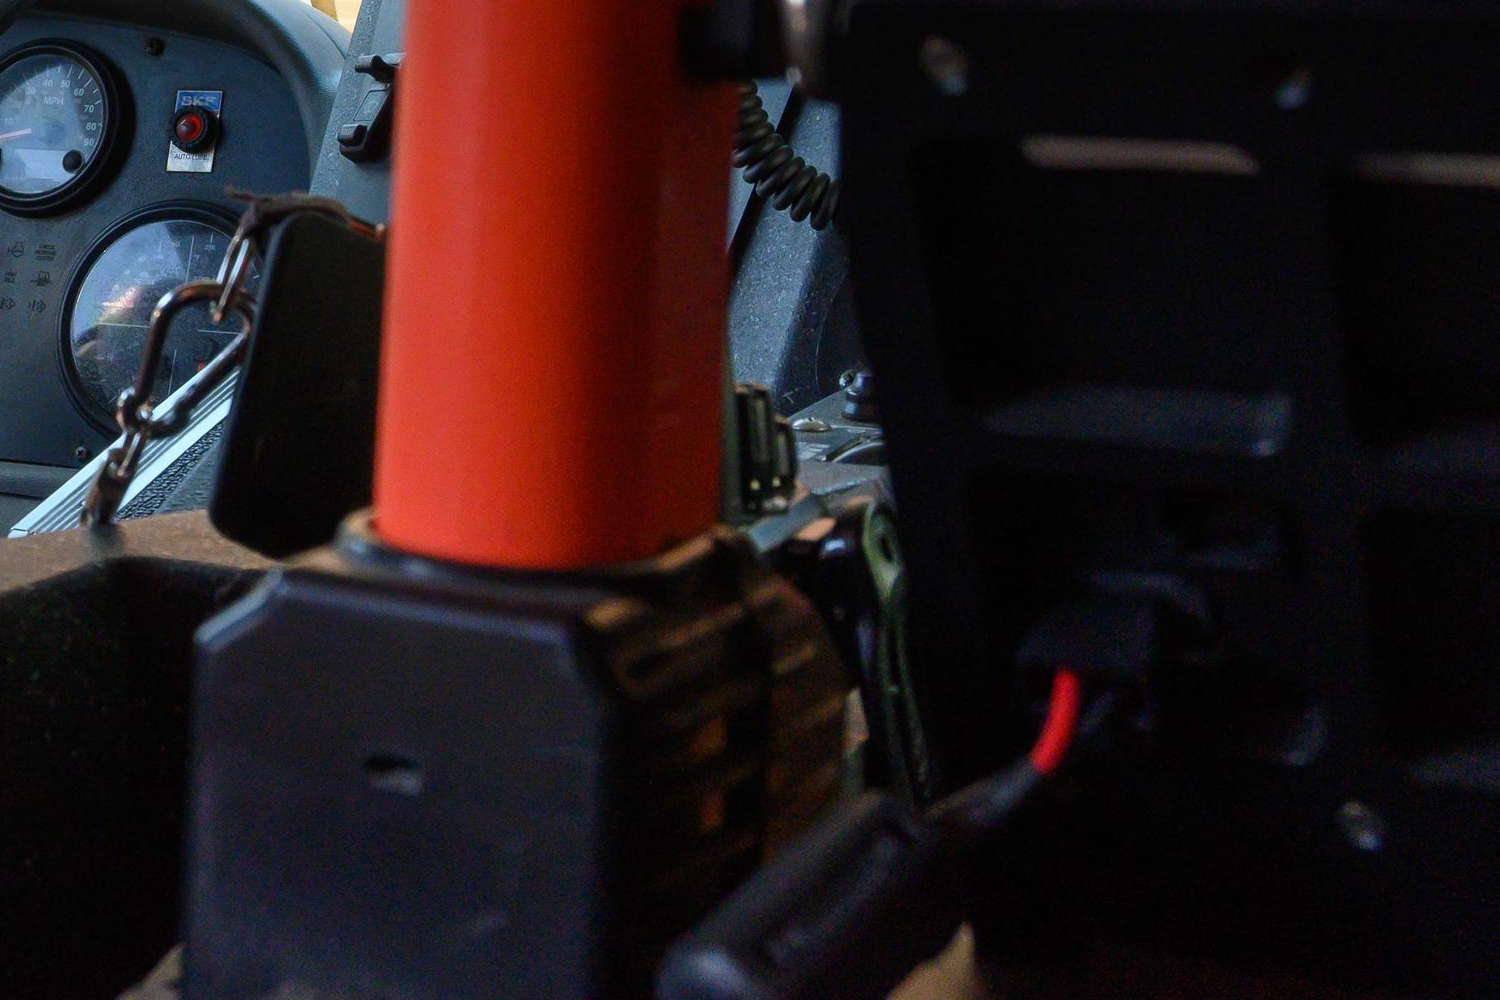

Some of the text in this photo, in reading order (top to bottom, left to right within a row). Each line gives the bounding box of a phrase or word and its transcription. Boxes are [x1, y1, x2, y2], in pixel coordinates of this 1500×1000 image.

[73, 88, 85, 98] 60
[43, 95, 65, 105] MPH
[181, 95, 217, 107] SKF
[84, 104, 95, 114] 70
[83, 137, 95, 147] 90
